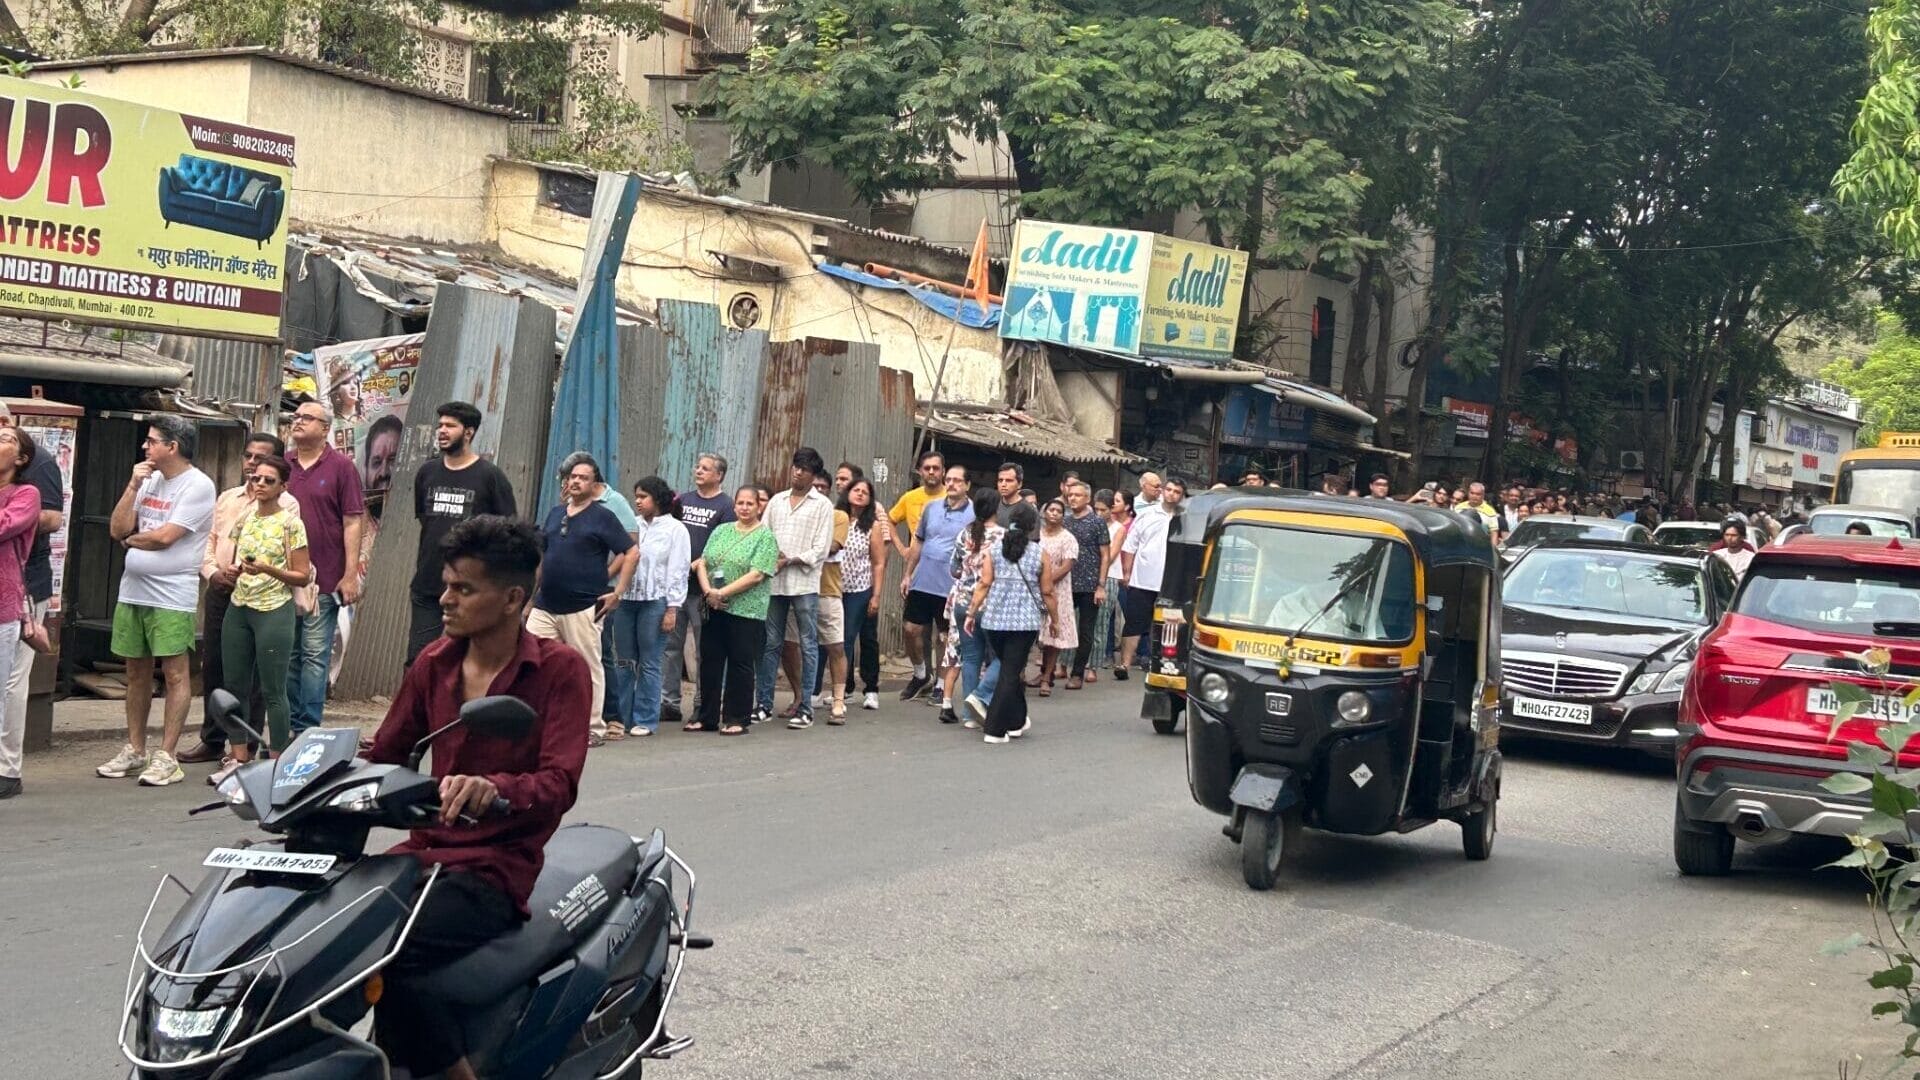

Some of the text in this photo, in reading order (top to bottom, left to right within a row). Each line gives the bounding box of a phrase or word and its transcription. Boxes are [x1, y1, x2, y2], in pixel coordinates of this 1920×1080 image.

[192, 125, 294, 159] Moin: 9082032485
[1021, 230, 1139, 274] Aadil
[0, 256, 242, 308] NDED MATTRESS & CURTAIN
[1167, 252, 1231, 308] Aadil
[0, 288, 25, 304] Road,
[28, 292, 75, 310] Chandivali,
[78, 298, 112, 313] Mumbai
[120, 304, 136, 316] 400
[434, 492, 465, 504] LIMITED
[682, 505, 717, 518] TOMMY
